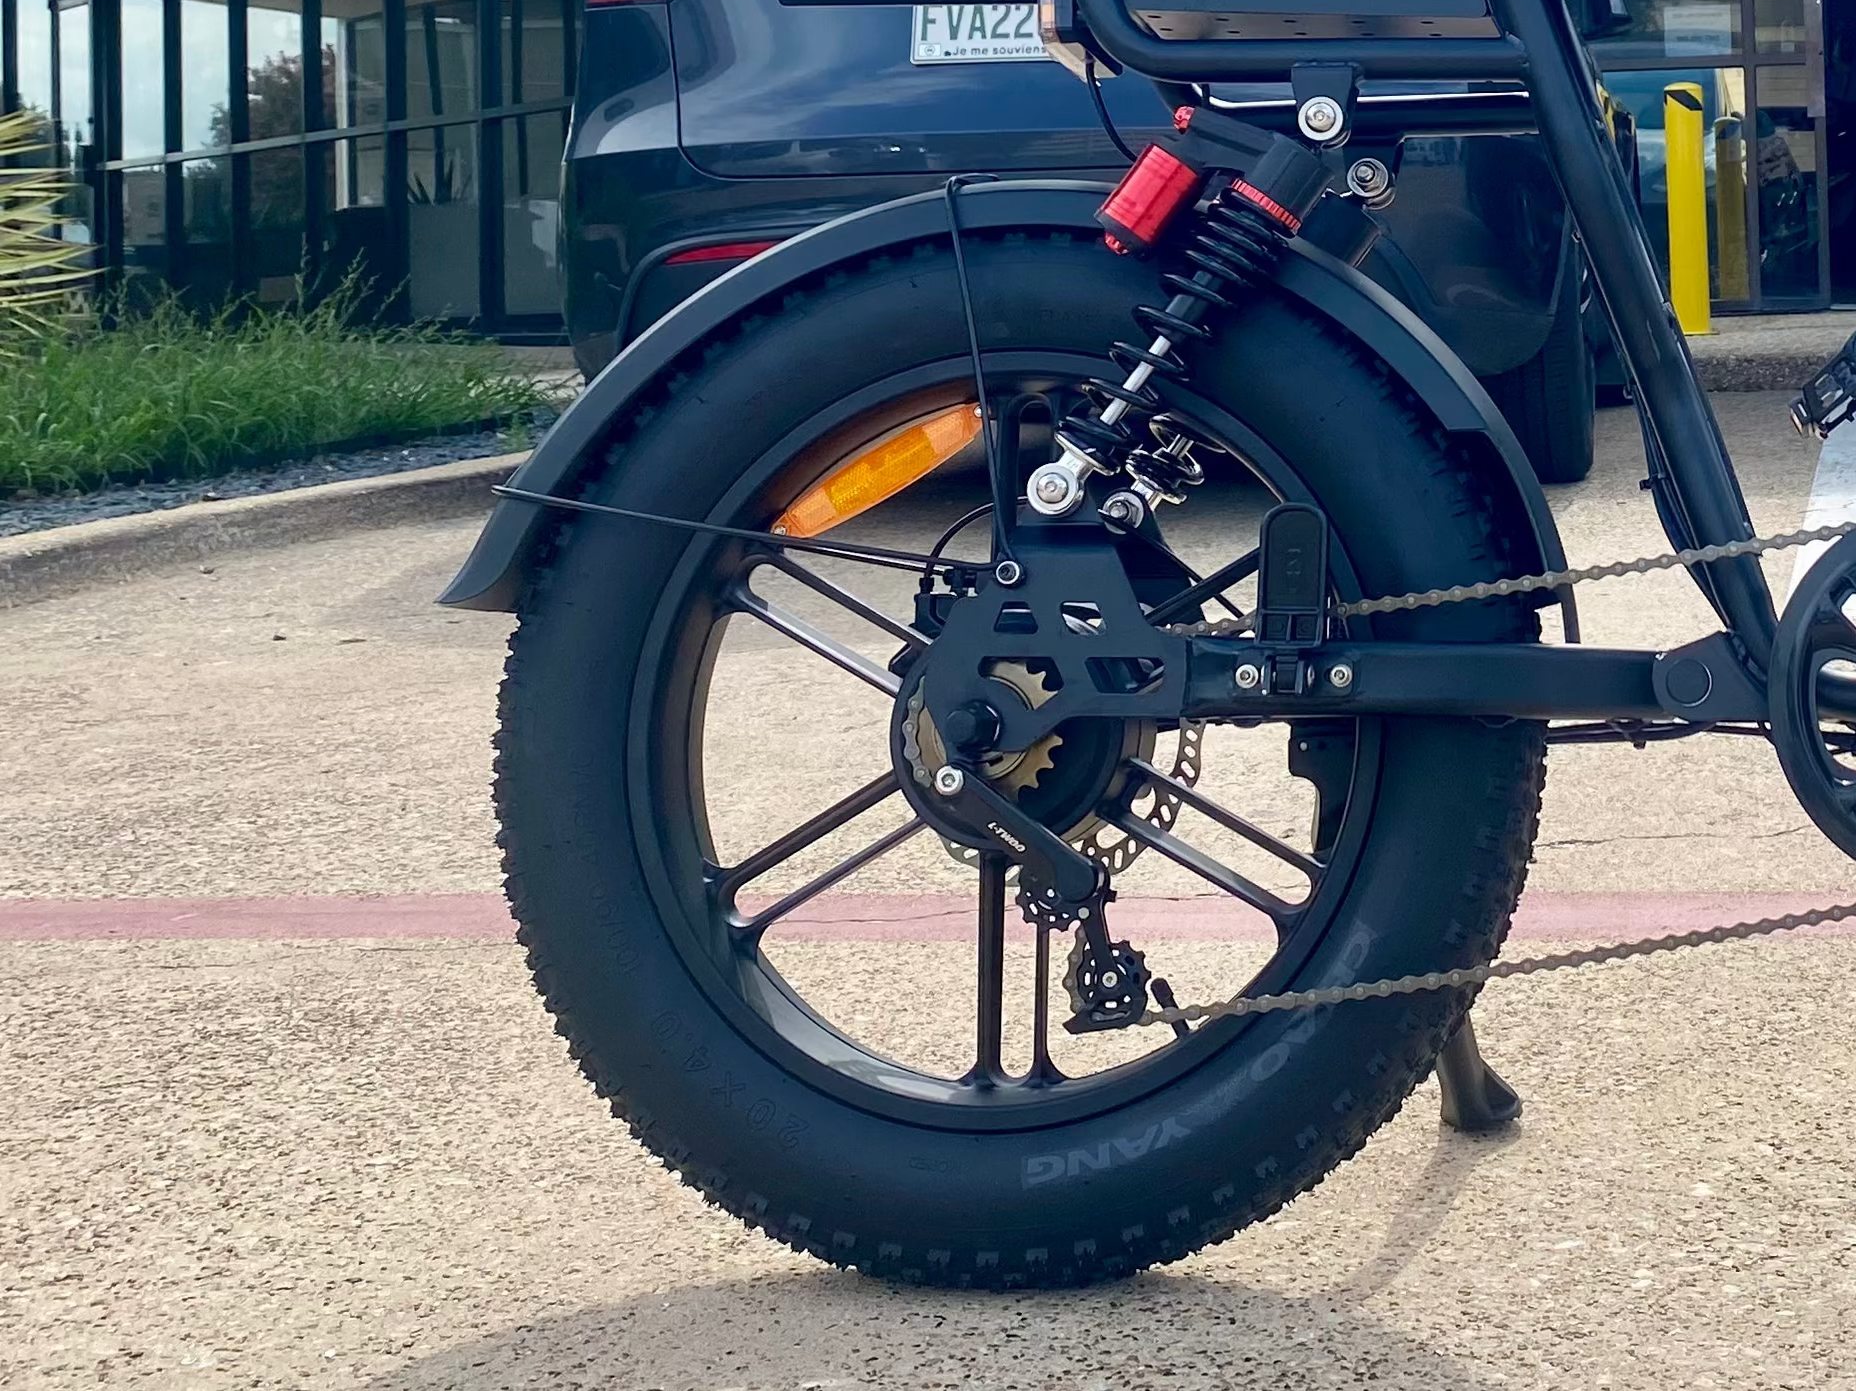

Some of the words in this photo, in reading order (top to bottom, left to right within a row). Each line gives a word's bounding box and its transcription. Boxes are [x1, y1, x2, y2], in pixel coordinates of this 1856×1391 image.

[952, 46, 967, 56] Je
[970, 47, 989, 56] me
[992, 44, 1048, 55] souviens
[1024, 1115, 1193, 1185] YANG
